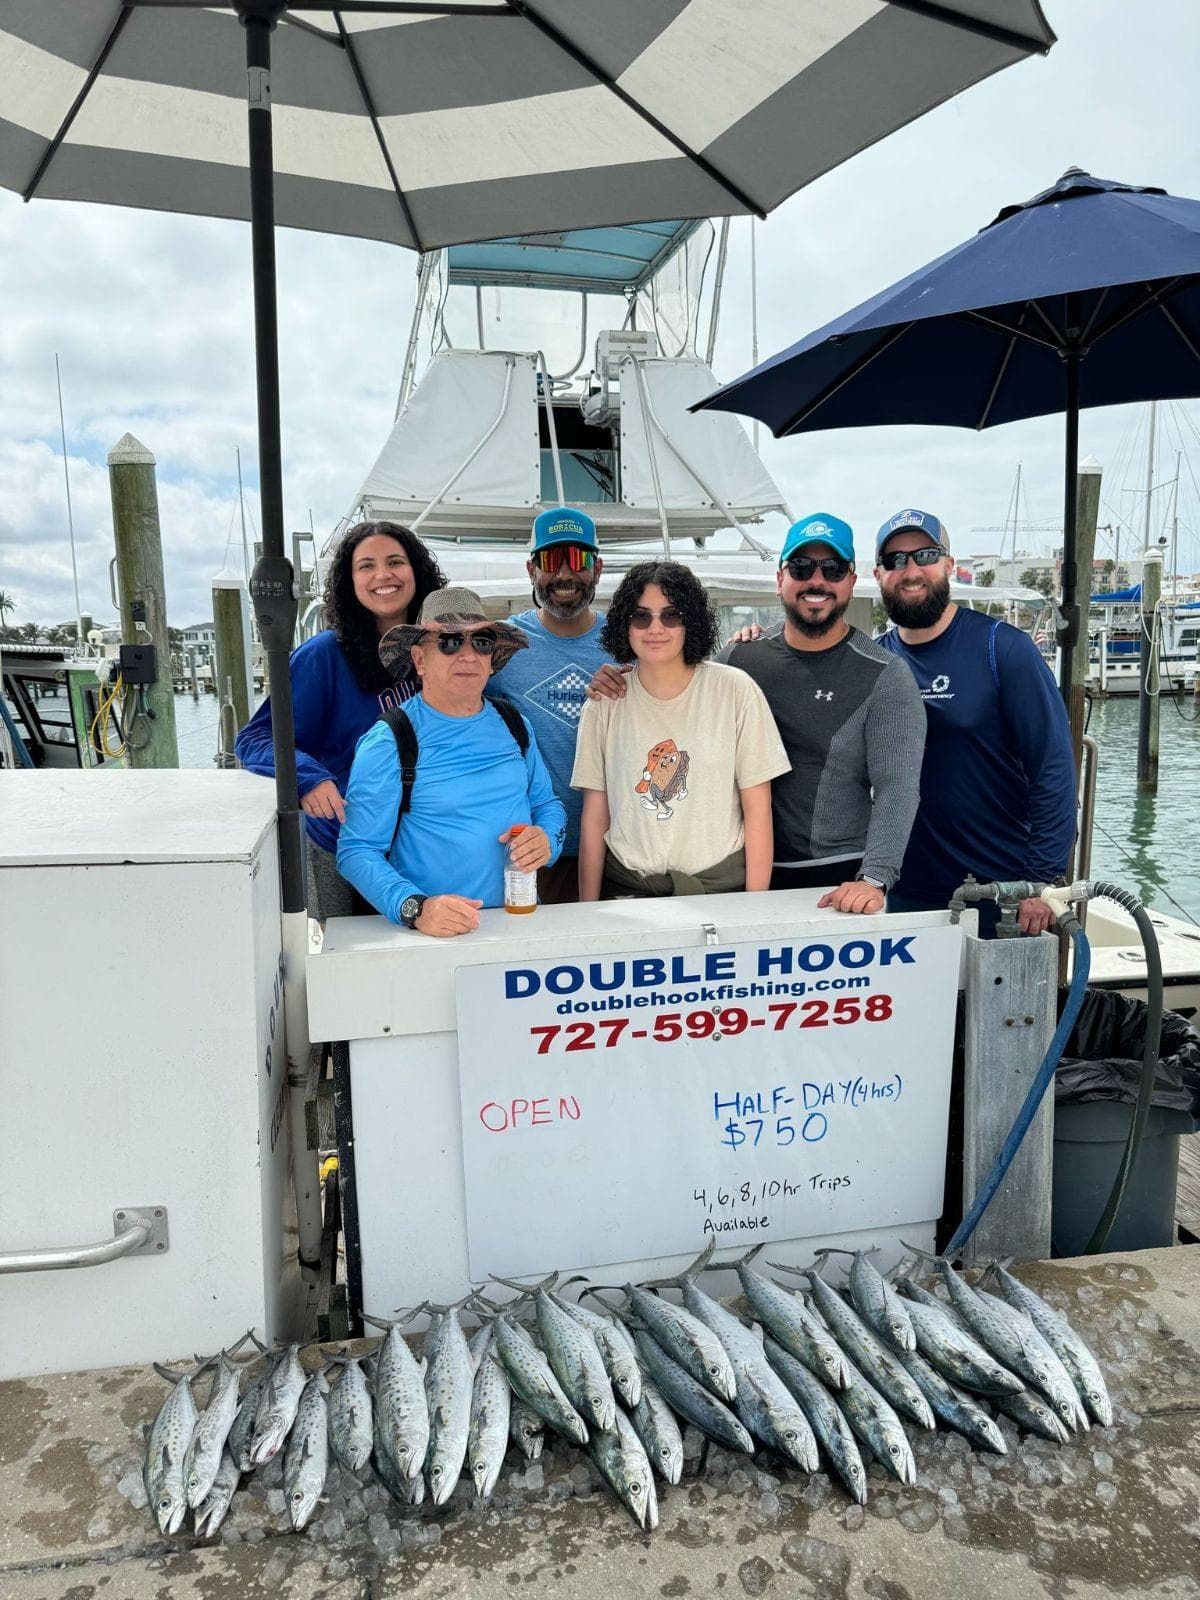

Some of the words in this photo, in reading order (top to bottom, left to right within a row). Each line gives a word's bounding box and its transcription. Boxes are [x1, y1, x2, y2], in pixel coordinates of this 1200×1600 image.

[548, 690, 586, 703] Hurley
[505, 951, 736, 1000] DOUBLE
[757, 936, 917, 977] HOOK
[556, 976, 870, 1015] doublehookfishing.com
[530, 994, 893, 1056] 727-599-7258
[480, 1095, 581, 1132] OPEN
[721, 1112, 828, 1151] $750
[809, 1173, 852, 1191] Trips
[703, 1216, 770, 1235] Available
